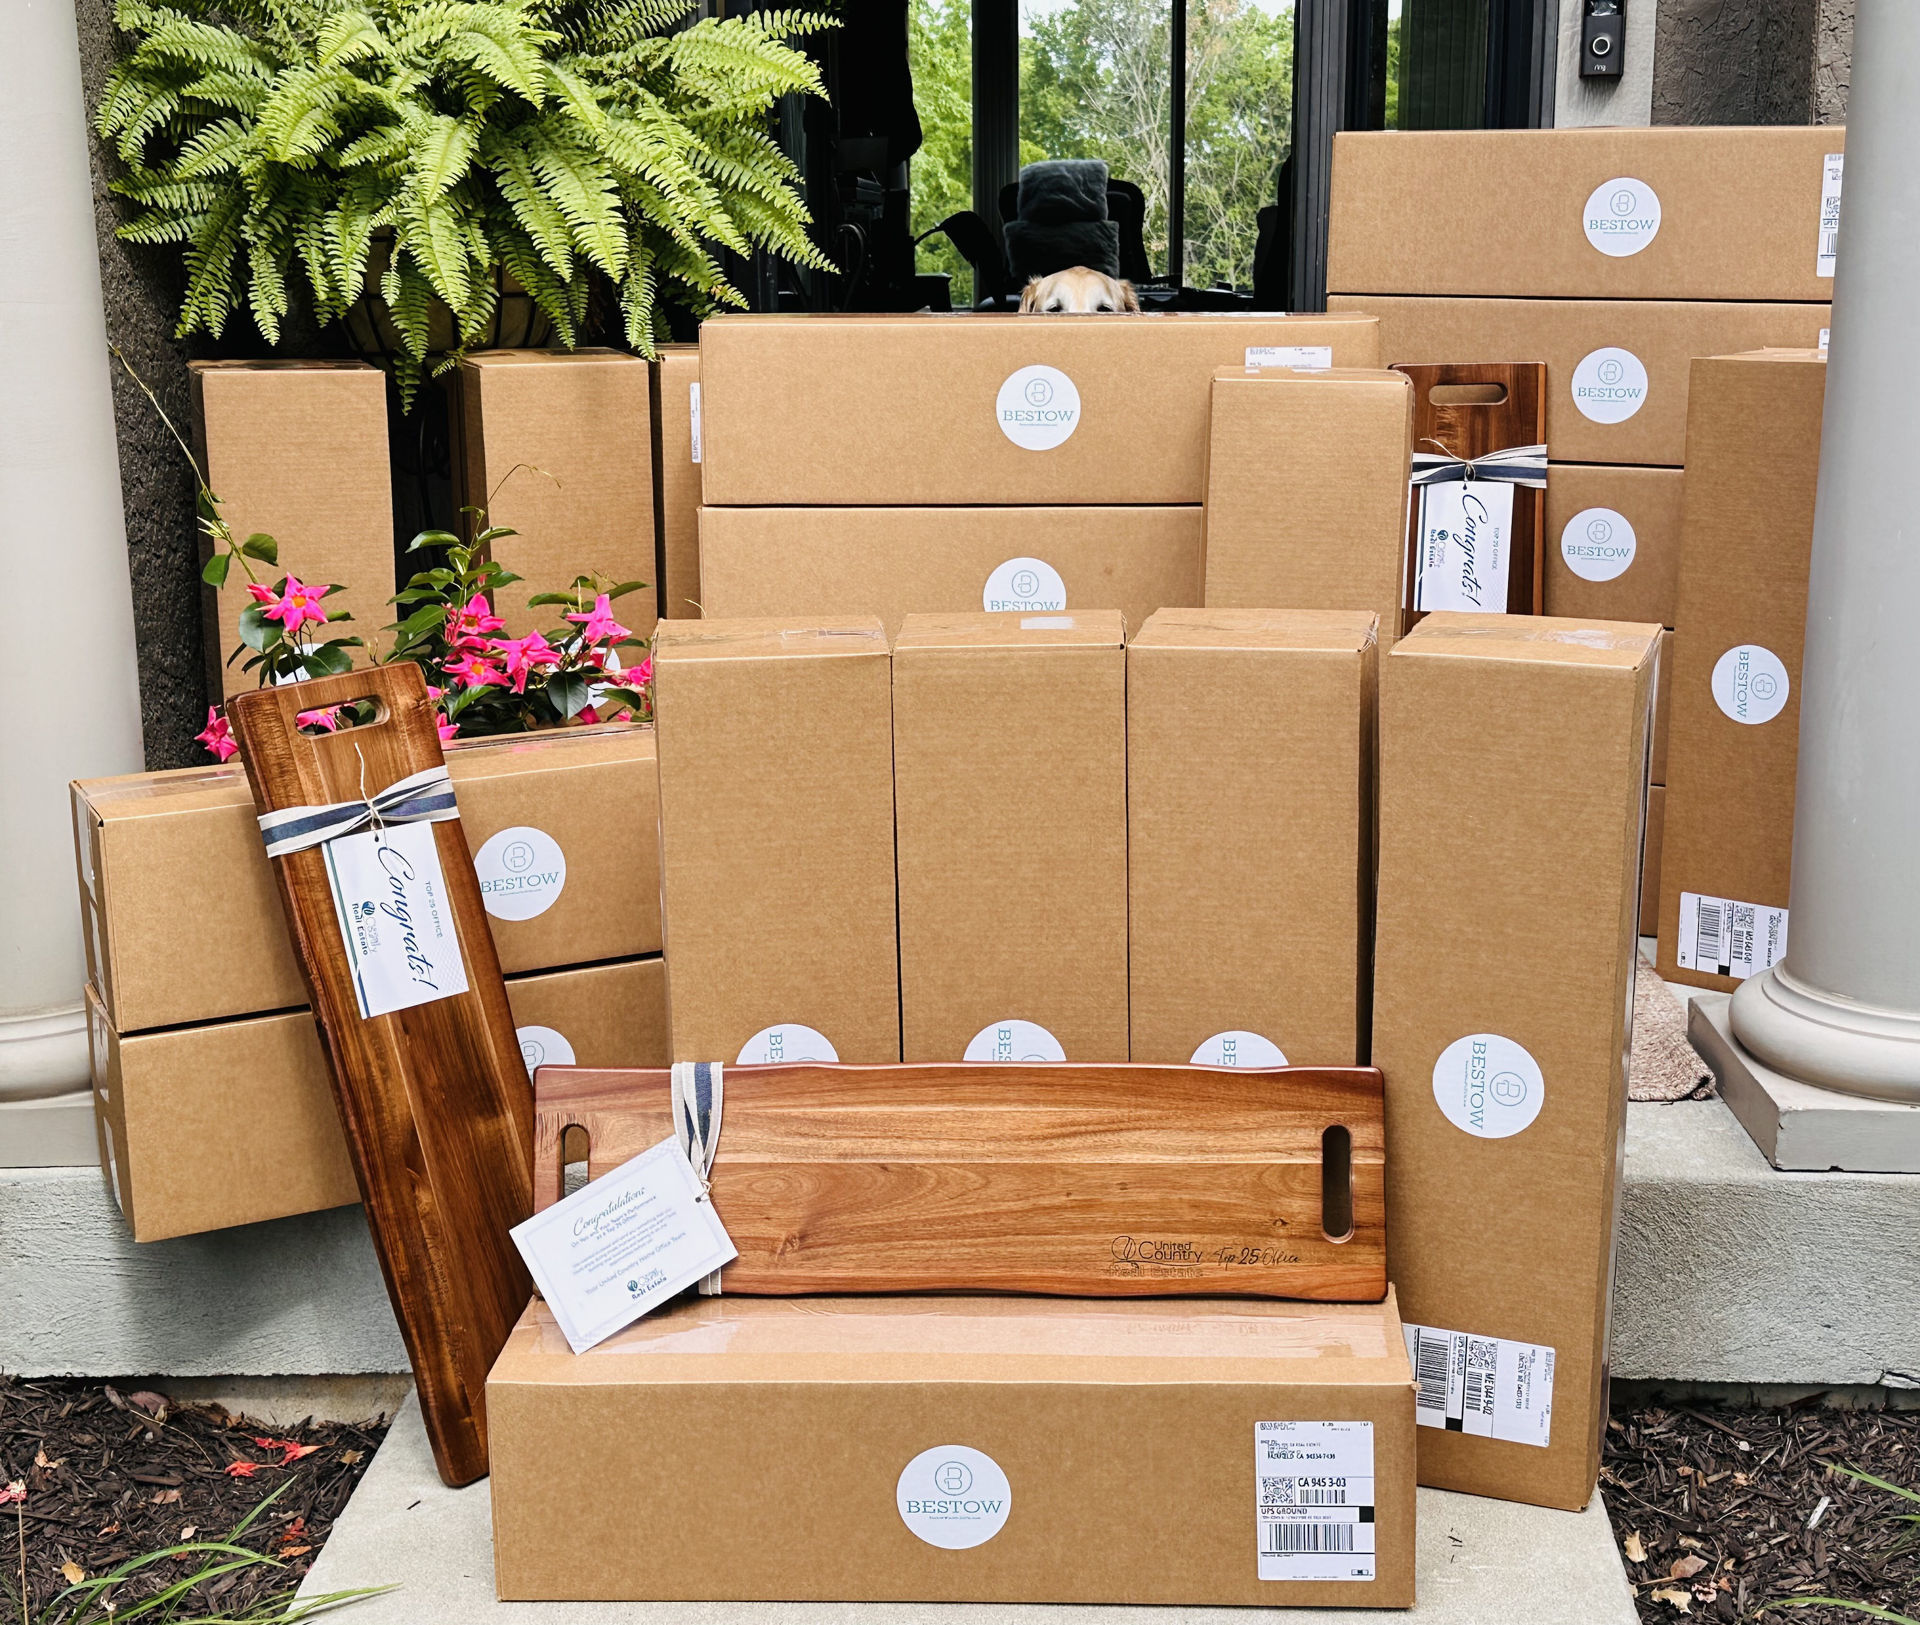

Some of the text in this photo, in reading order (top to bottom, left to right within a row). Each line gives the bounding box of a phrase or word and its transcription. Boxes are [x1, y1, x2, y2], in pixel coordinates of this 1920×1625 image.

[1589, 220, 1654, 229] BESTOW
[1578, 387, 1641, 398] BESTOW
[1003, 410, 1074, 421] BESTOW
[1453, 494, 1488, 606] Congrats!
[1567, 545, 1630, 557] BESTOW
[990, 600, 1059, 611] BESTOW
[1737, 651, 1749, 718] BESTOW
[481, 872, 559, 892] BESTOW
[378, 847, 438, 990] Congrats!
[769, 1033, 783, 1063] BE
[1470, 1041, 1486, 1129] BESTOW
[1154, 1241, 1192, 1251] United
[1139, 1241, 1202, 1262] Country
[1238, 1248, 1261, 1265] 25
[1298, 1478, 1346, 1487] CA 945 3-03
[907, 1501, 1002, 1513] BESTOW
